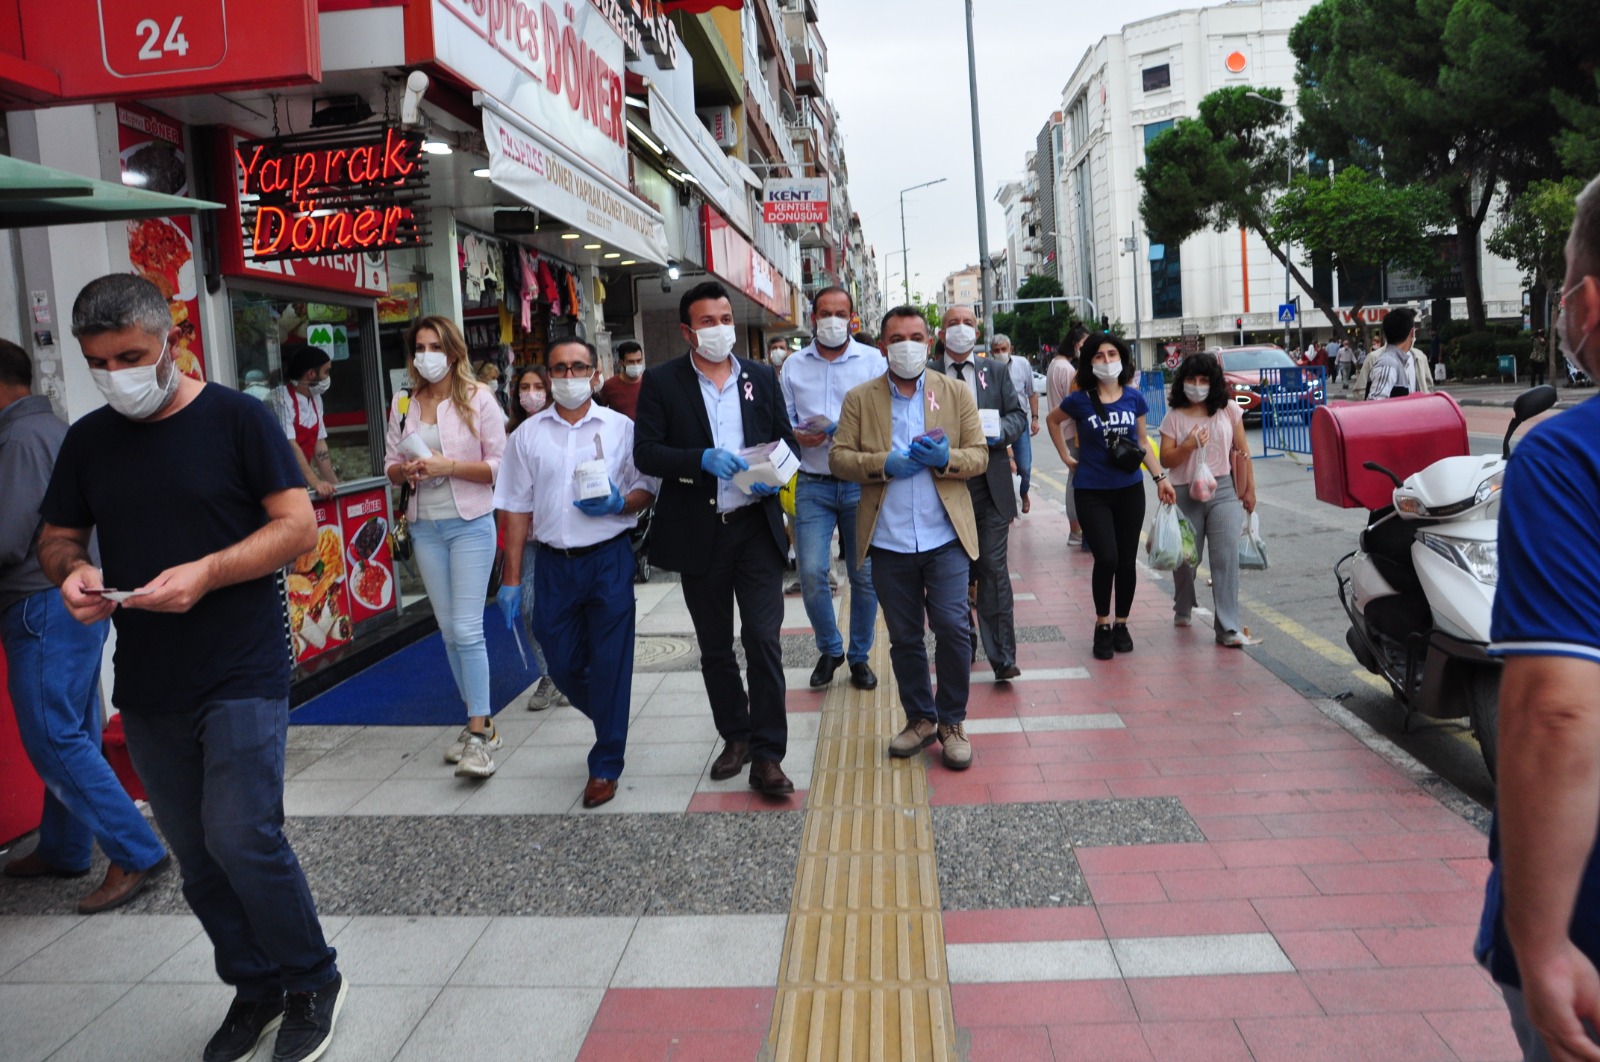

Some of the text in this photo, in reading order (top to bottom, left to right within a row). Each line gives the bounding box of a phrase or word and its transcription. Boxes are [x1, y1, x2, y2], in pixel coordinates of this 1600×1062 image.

[136, 15, 190, 60] 24
[541, 0, 625, 148] DÖNER
[144, 116, 180, 144] DÖNER
[234, 128, 413, 202] Yaprak
[544, 153, 574, 195] DÖNER
[769, 190, 812, 201] KENT
[774, 202, 817, 211] KENTSEL
[253, 200, 403, 255] Döner
[768, 209, 823, 222] DÖNÜŞÜM
[1087, 410, 1135, 429] TDAY
[361, 499, 381, 514] DÖNER
